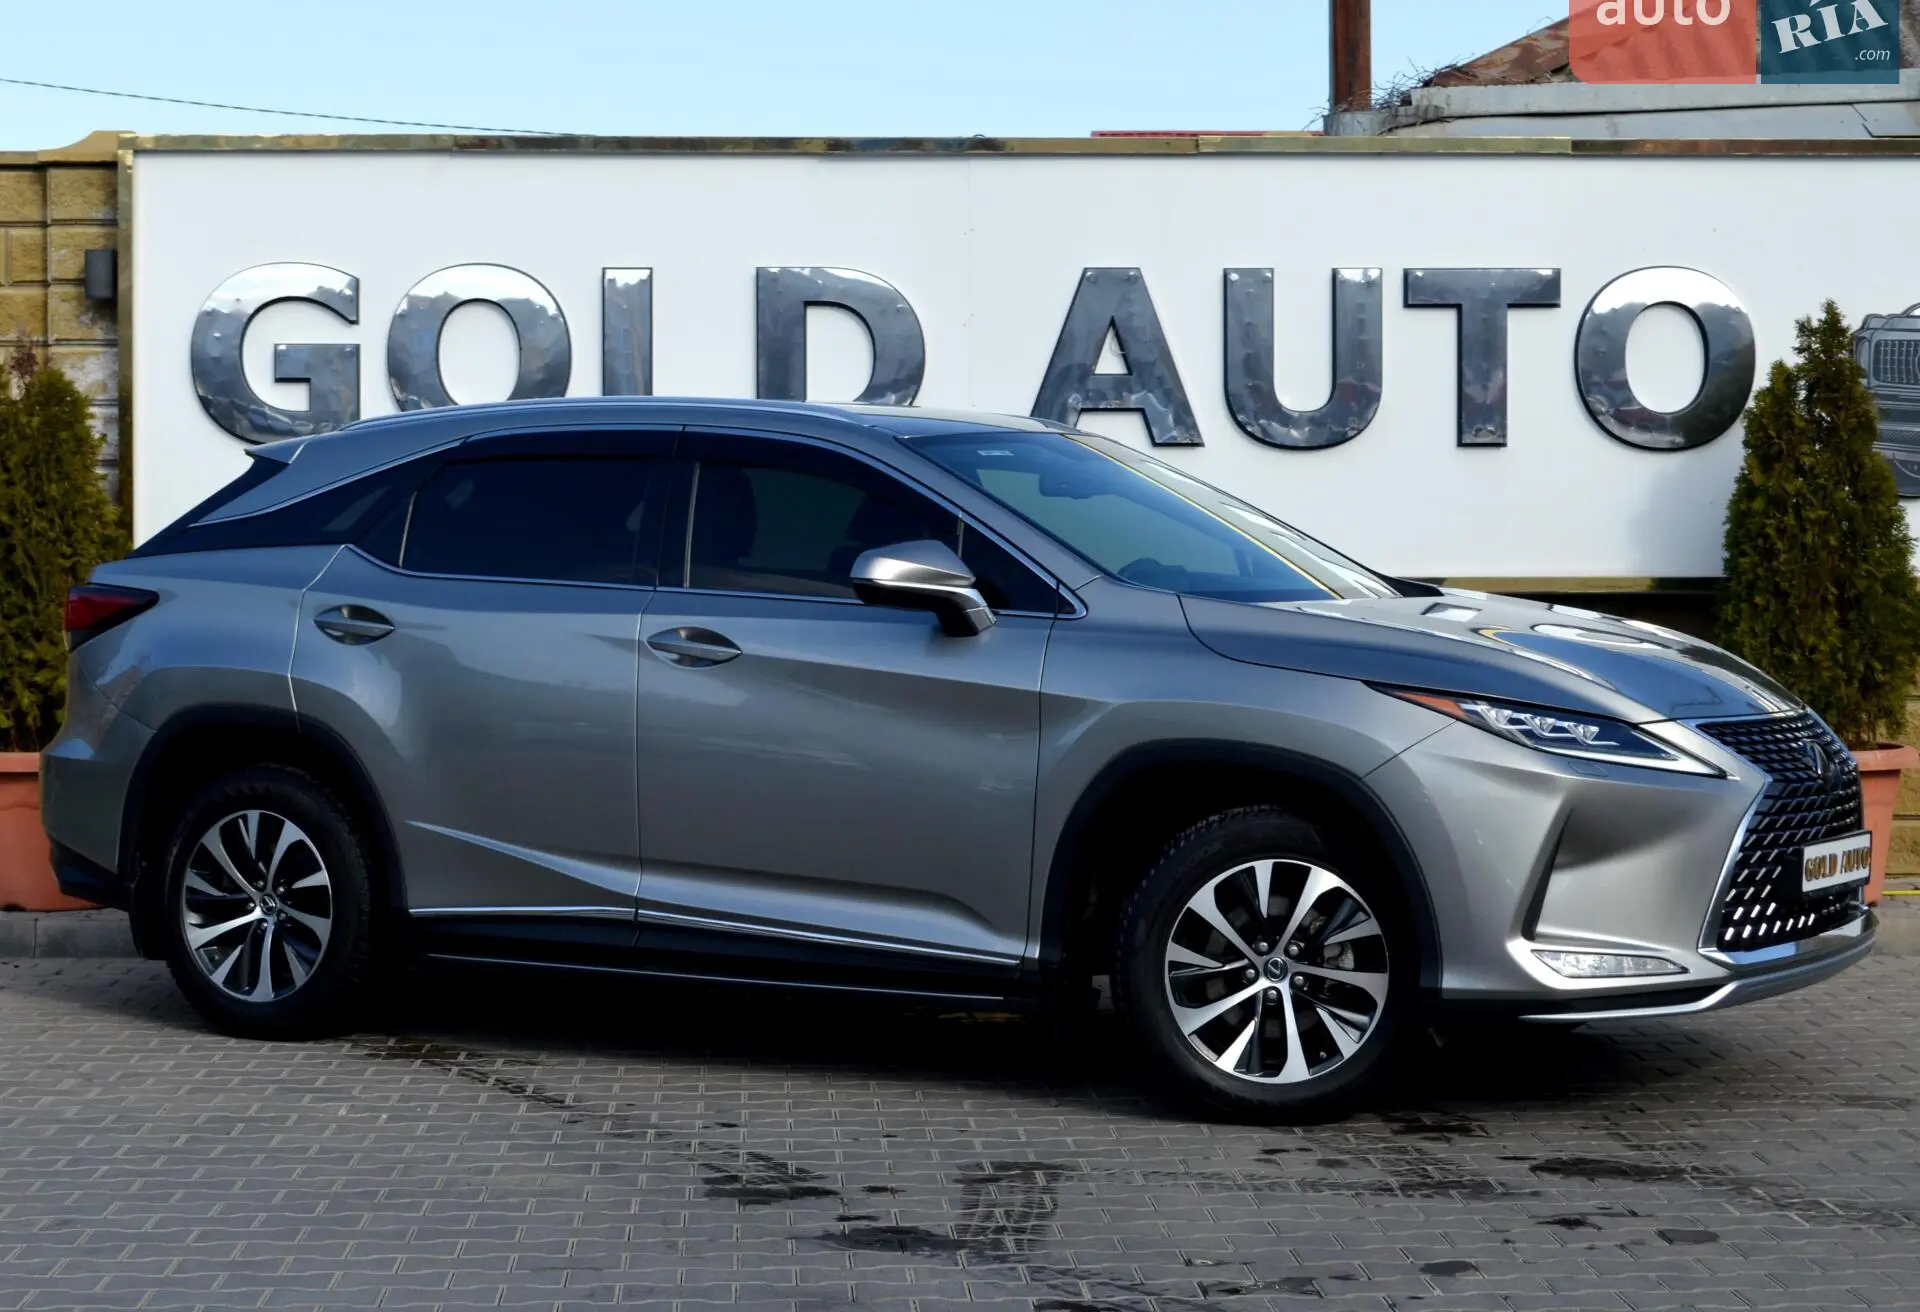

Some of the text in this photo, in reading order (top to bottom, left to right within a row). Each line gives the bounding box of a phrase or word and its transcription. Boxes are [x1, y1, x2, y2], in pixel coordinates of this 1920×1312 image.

[1030, 265, 1758, 450] AUTO
[1805, 847, 1870, 882] GOLD AUTO
